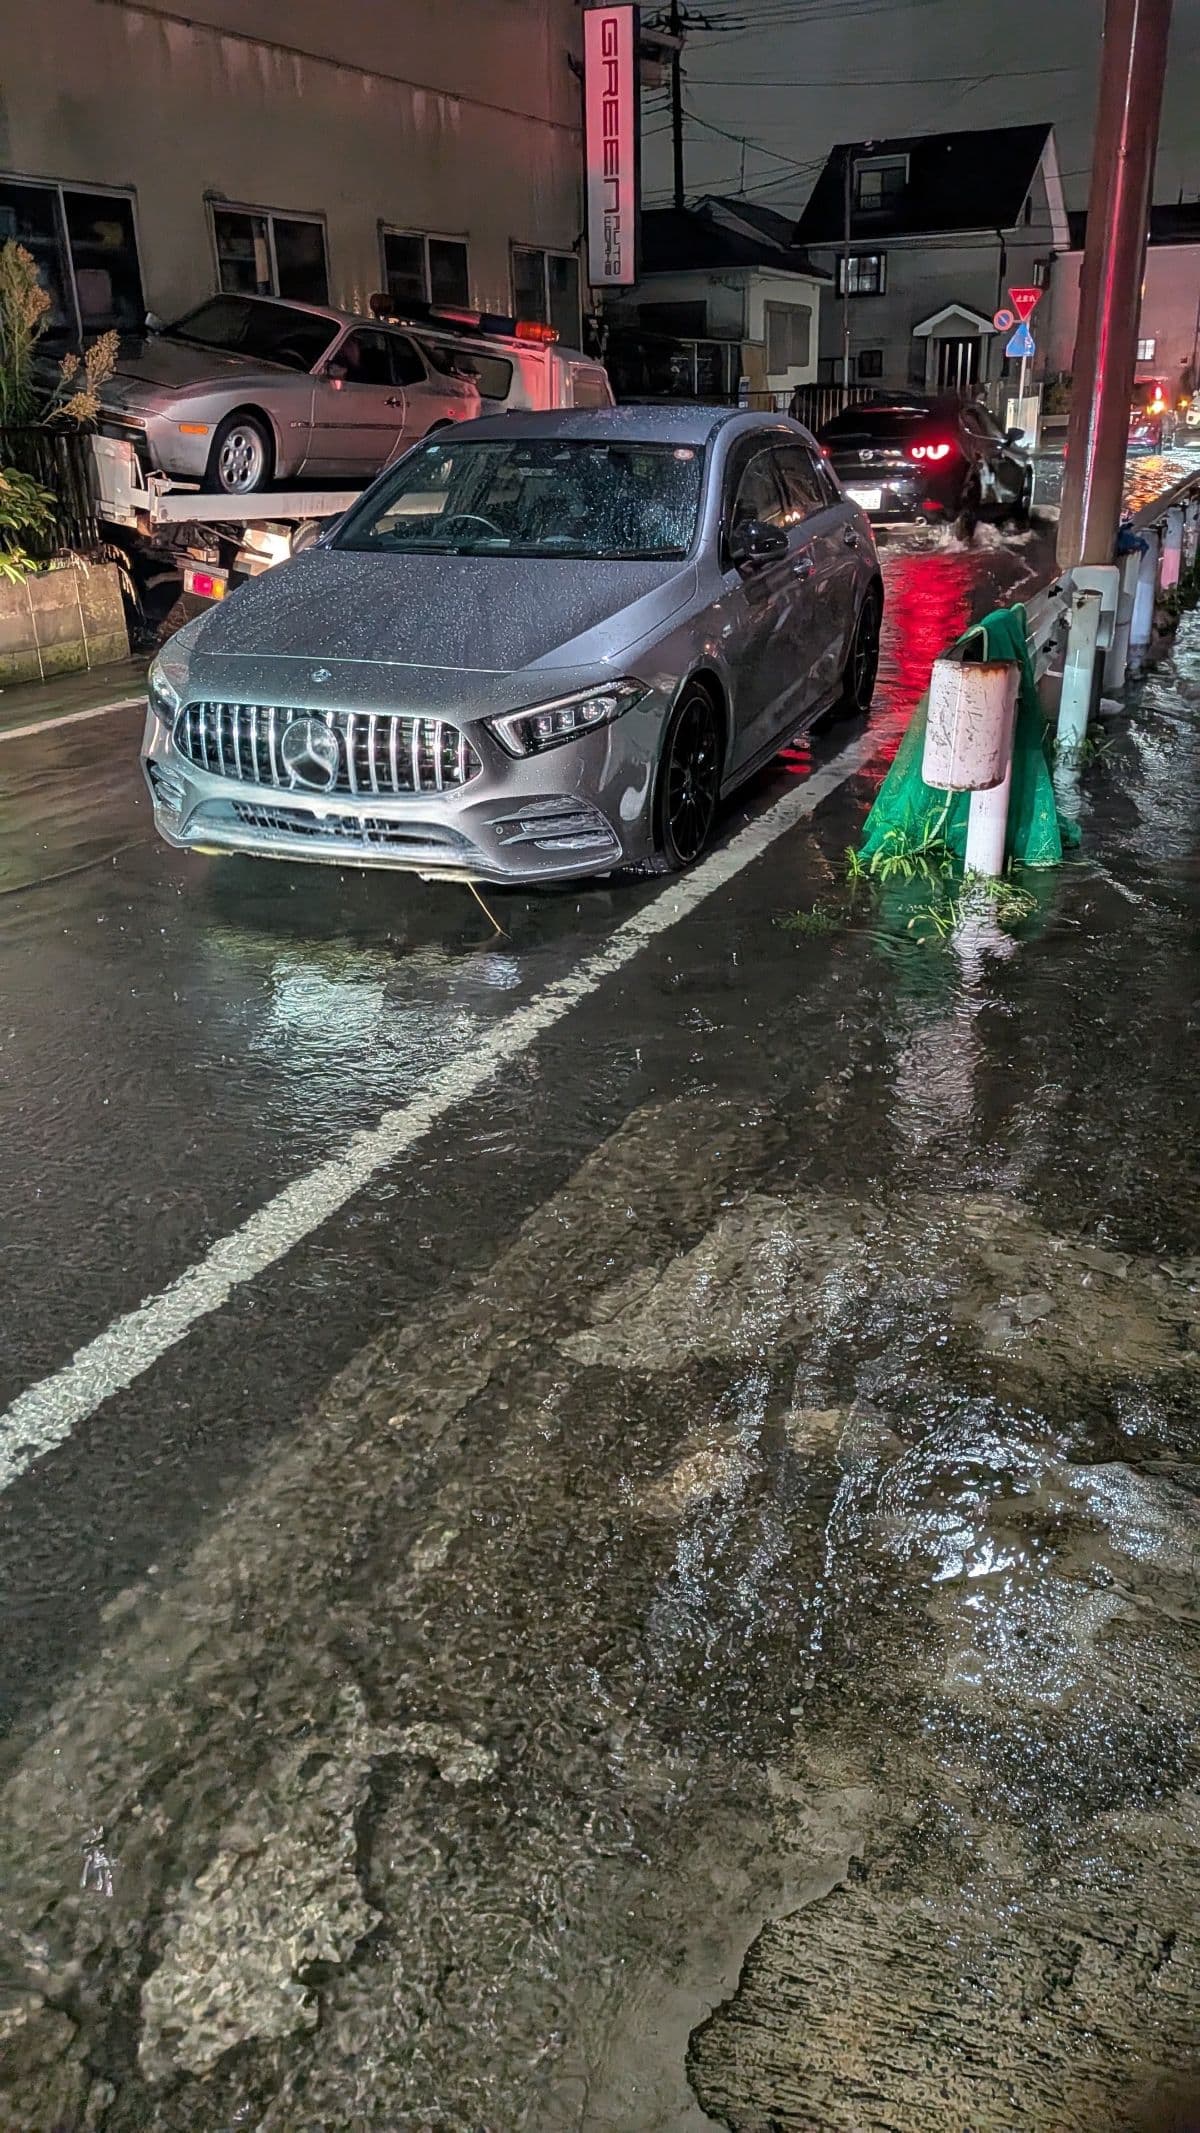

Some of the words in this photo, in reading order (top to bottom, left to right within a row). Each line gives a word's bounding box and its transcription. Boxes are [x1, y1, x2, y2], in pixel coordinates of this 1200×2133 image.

[602, 18, 620, 214] GREEN
[613, 215, 621, 275] AUTO
[1015, 294, 1036, 303] 止まれ
